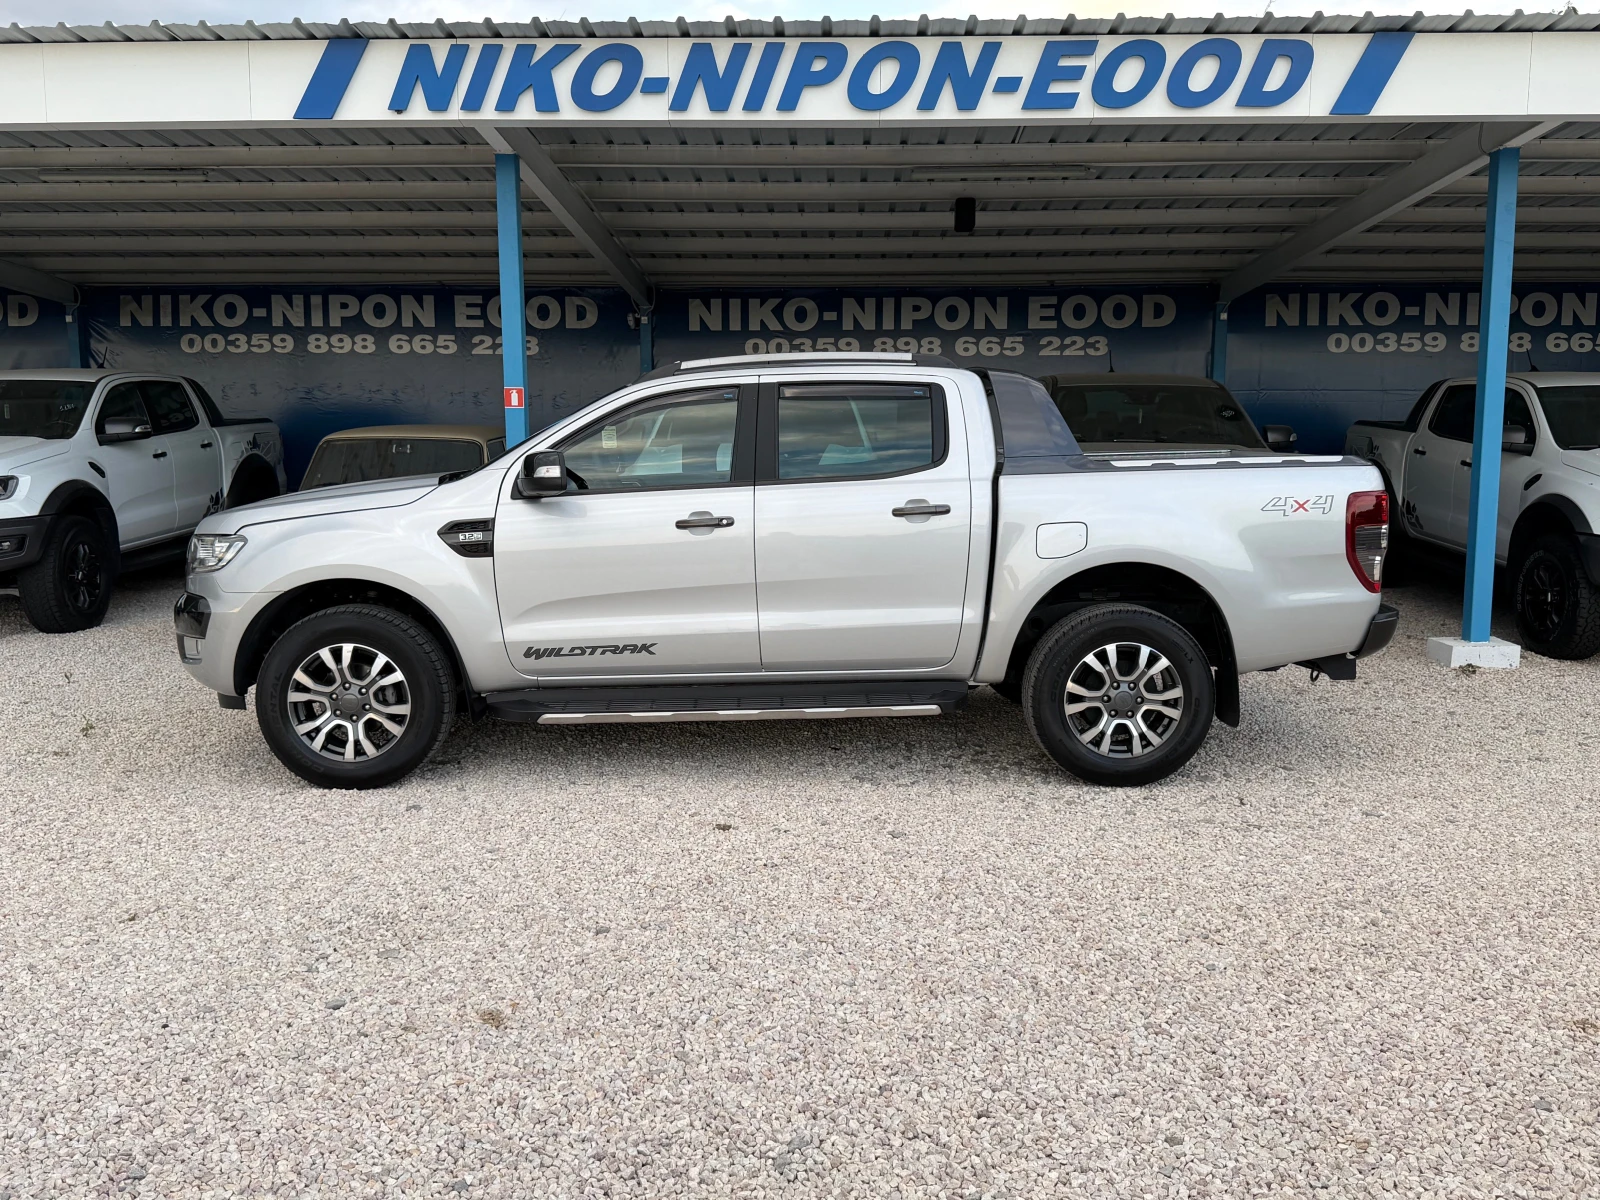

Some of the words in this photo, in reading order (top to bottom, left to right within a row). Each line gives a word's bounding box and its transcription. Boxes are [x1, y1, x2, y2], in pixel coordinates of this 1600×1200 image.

[388, 38, 1315, 112] NIKO-NIPON-EOOD
[0, 294, 39, 327] D
[119, 294, 435, 328] NIKO-NIPON
[687, 296, 1008, 331] NIKO-NIPON
[1027, 294, 1177, 330] EOOD
[1265, 291, 1598, 327] NIKO-NION
[180, 333, 295, 354] 00359
[307, 333, 376, 354] 898
[388, 334, 458, 355] 665
[744, 336, 860, 355] 00359
[873, 336, 942, 356] 898
[954, 336, 1025, 357] 665
[1038, 335, 1109, 356] 223
[1326, 332, 1447, 353] 00359
[1460, 331, 1532, 353] 88
[1545, 332, 1600, 353] 66
[523, 642, 659, 660] WILDTRAK
